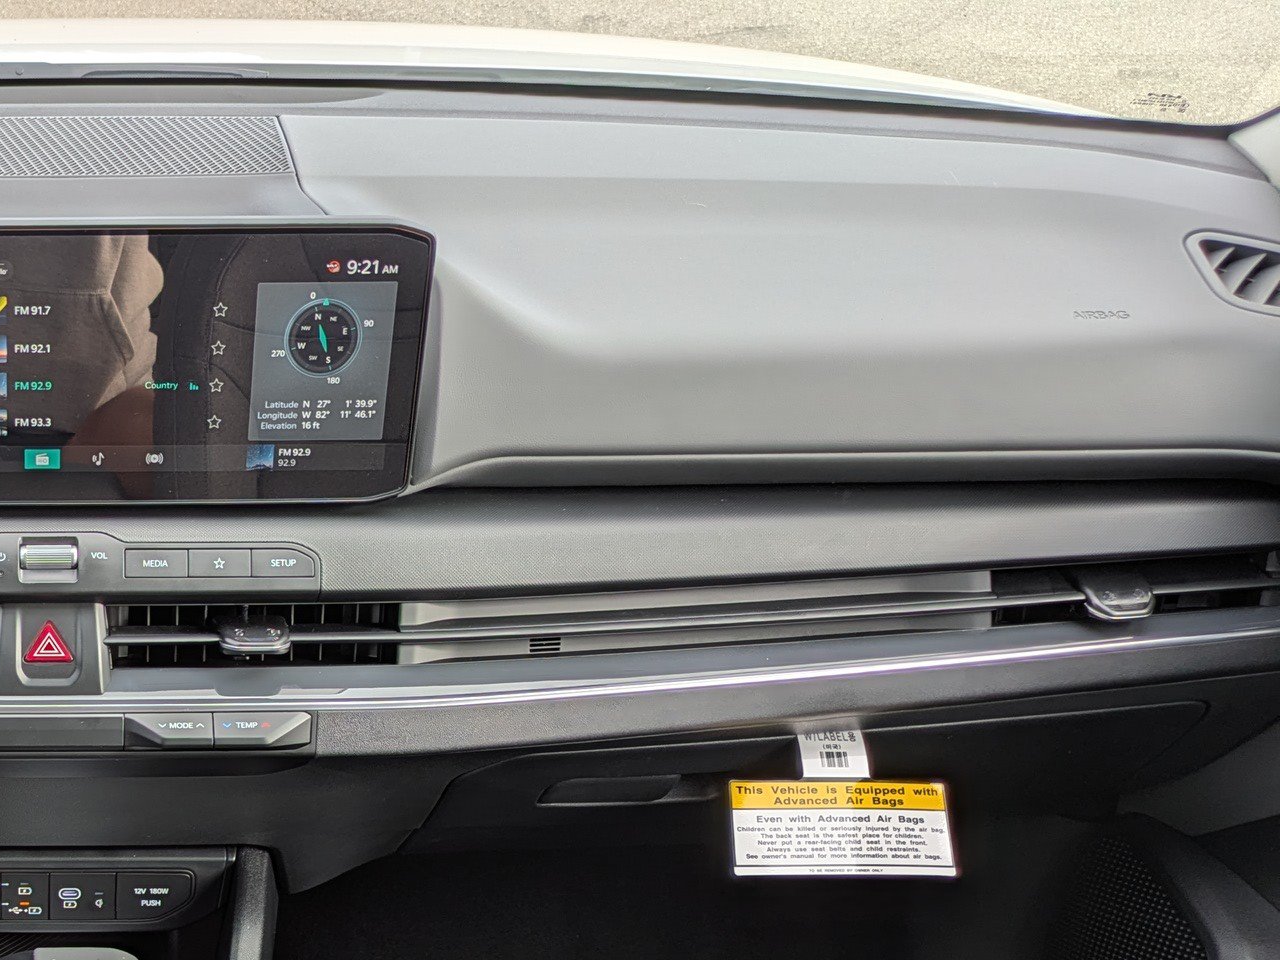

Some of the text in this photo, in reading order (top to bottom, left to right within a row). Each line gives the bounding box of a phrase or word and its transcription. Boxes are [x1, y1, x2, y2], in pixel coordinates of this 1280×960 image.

[347, 260, 379, 275] 9:21
[382, 265, 399, 274] AM
[14, 306, 51, 316] FM 91.7
[1073, 310, 1130, 320] AIRBAG
[364, 320, 374, 328] 90
[14, 344, 51, 354] FM 92.1
[297, 342, 307, 350] W
[270, 350, 286, 358] 270
[326, 356, 331, 364] S
[327, 376, 341, 384] 180
[14, 382, 179, 391] FM 92.9 Country
[265, 400, 299, 409] Latitude
[316, 400, 331, 408] 27°
[257, 411, 298, 420] Longitude
[316, 411, 330, 419] 82°
[14, 418, 52, 428] FM 93.3
[260, 422, 321, 430] Elevation 16 ft
[278, 448, 312, 457] FM 92.9
[278, 459, 297, 467] 92.9
[91, 552, 108, 560] VOL
[142, 560, 169, 568] MEDIA
[270, 559, 297, 568] SETUP
[169, 722, 194, 730] MODE
[736, 786, 938, 797] This Vehicle is Equipped with
[774, 796, 905, 807] Advanced Air Bags
[756, 815, 925, 825] Even with Advanced Air Bags
